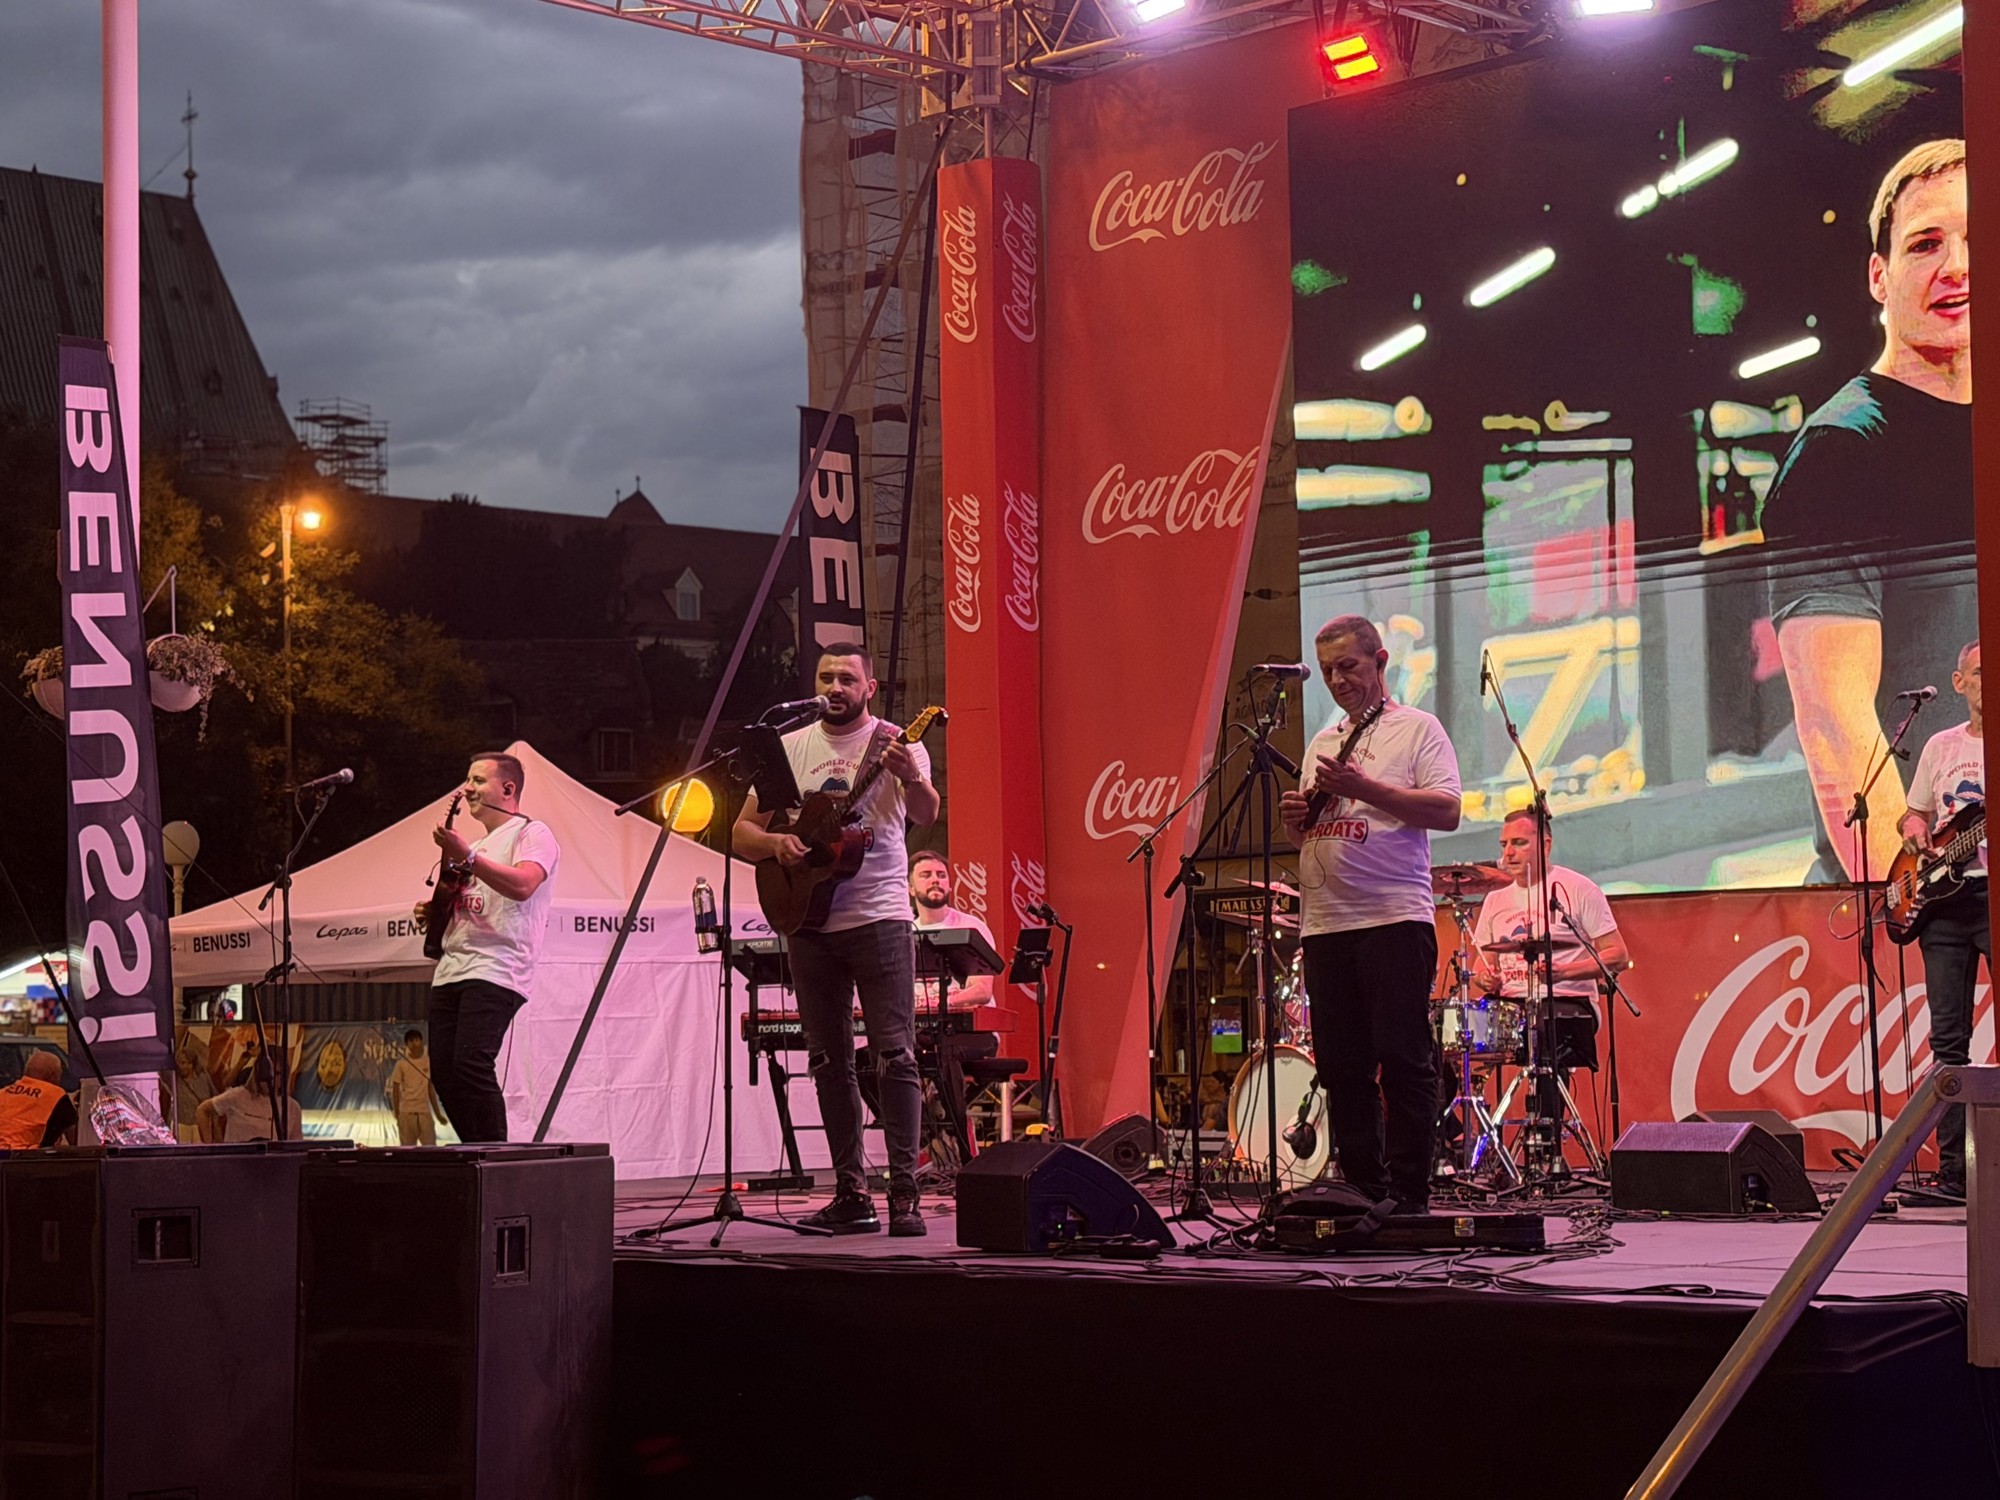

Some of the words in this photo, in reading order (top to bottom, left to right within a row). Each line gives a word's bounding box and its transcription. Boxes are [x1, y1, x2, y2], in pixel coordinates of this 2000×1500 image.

[1088, 139, 1279, 252] Coca-Cola
[943, 204, 978, 343] Coca-Cola
[1003, 191, 1037, 343] Coca-Cola
[947, 493, 982, 633] Coca-Cola
[1003, 480, 1040, 632] Coca-Cola
[810, 759, 845, 776] WORLD
[845, 761, 861, 771] CU
[1946, 761, 1979, 778] WORLD
[316, 924, 369, 941] Lepas
[5, 1084, 43, 1099] EDAR
